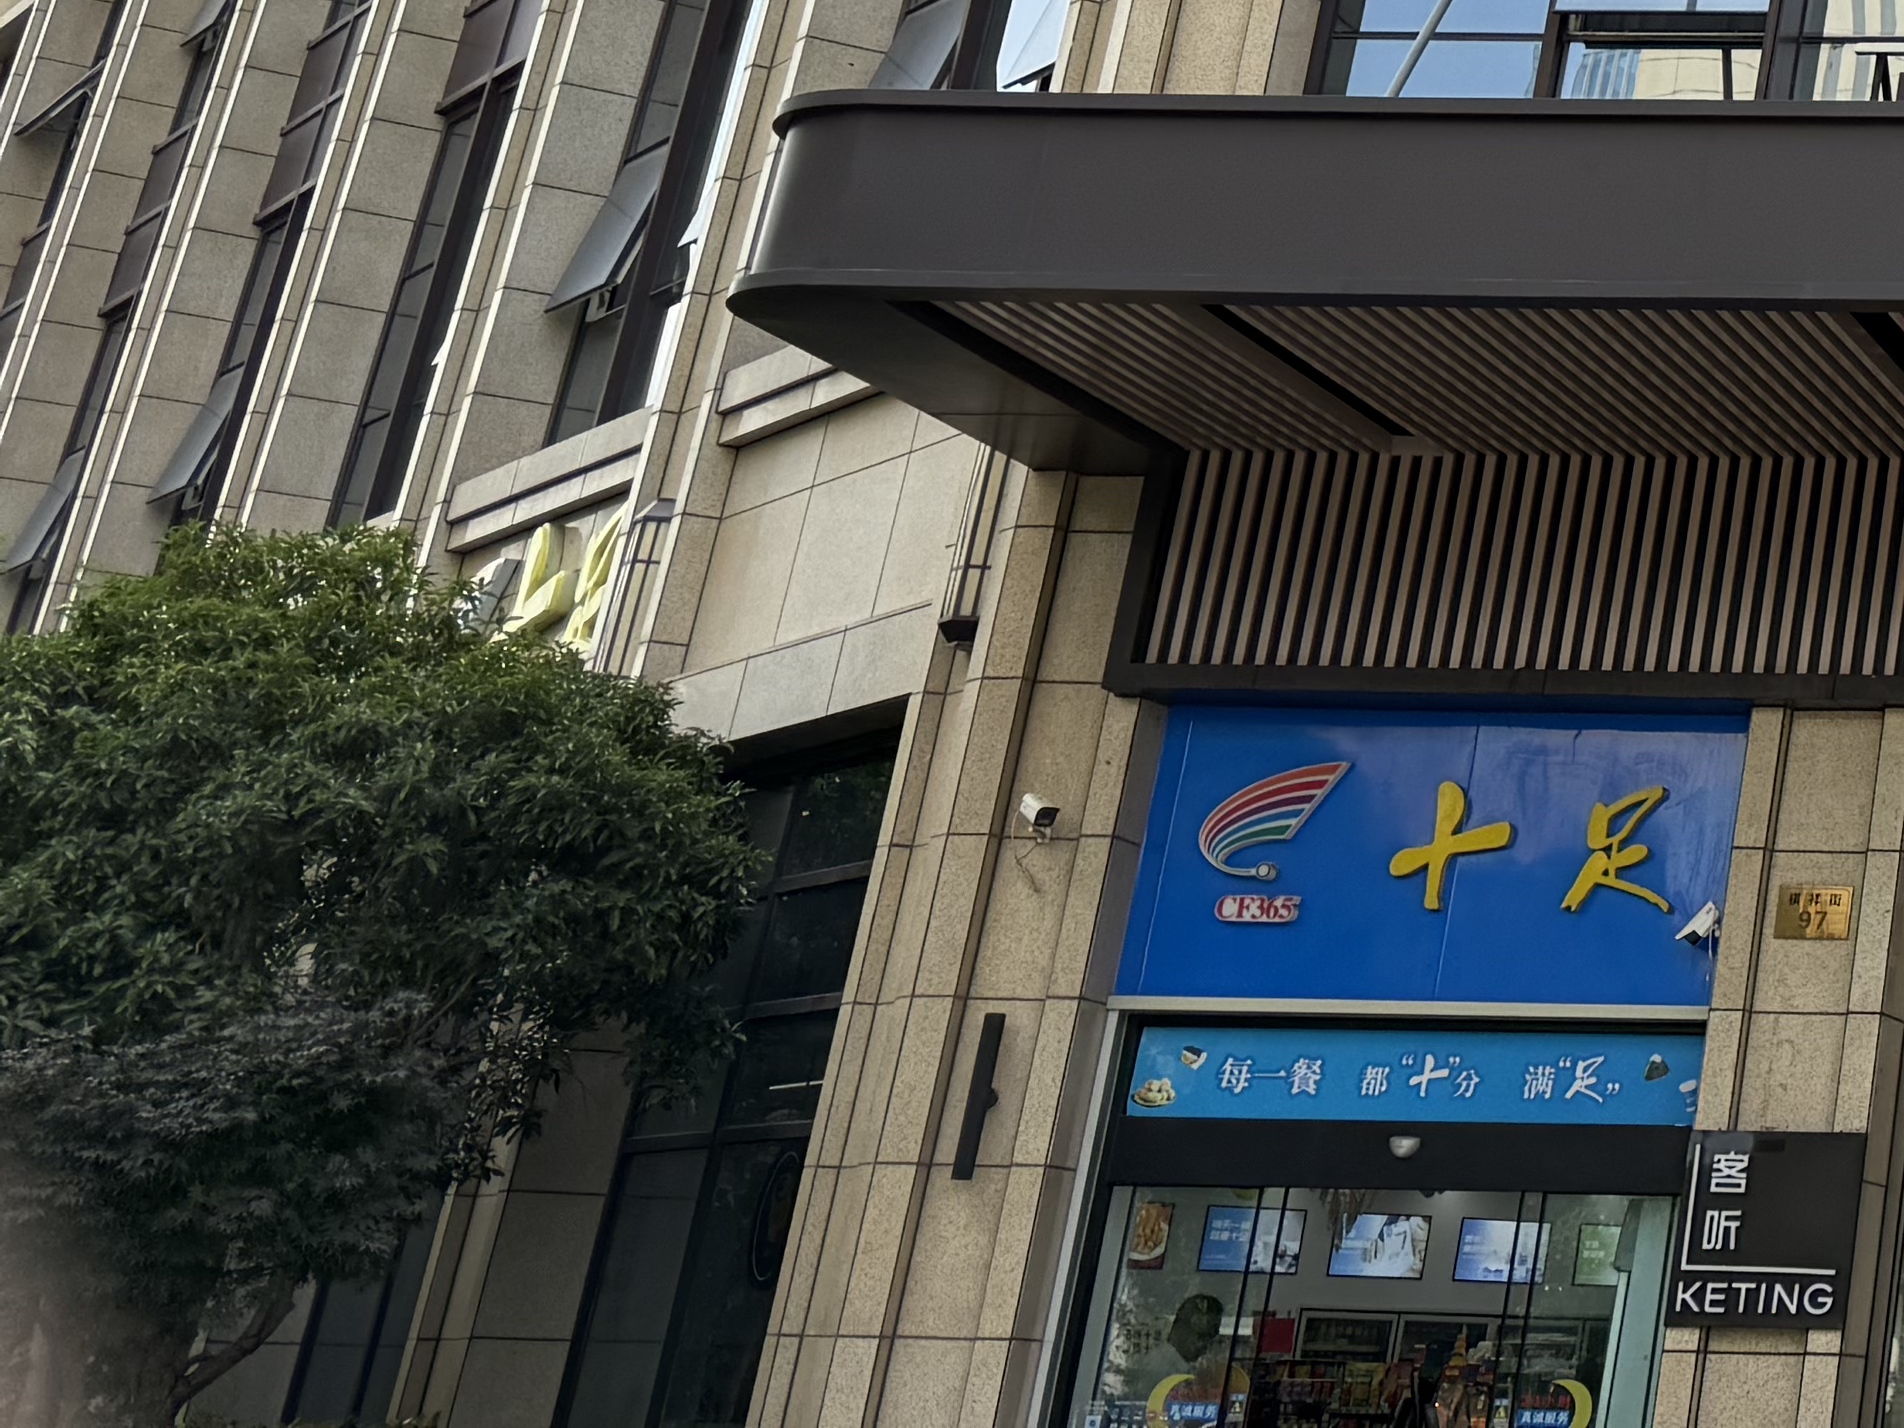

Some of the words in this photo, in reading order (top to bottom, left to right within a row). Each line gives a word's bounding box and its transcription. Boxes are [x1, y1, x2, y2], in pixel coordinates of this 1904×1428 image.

[1389, 781, 1671, 913] 十足
[1215, 895, 1296, 921] CF365
[1798, 910, 1828, 930] 97
[1218, 1056, 1323, 1096] 每一餐
[1702, 1150, 1750, 1250] 客听
[1675, 1280, 1834, 1316] KETING
